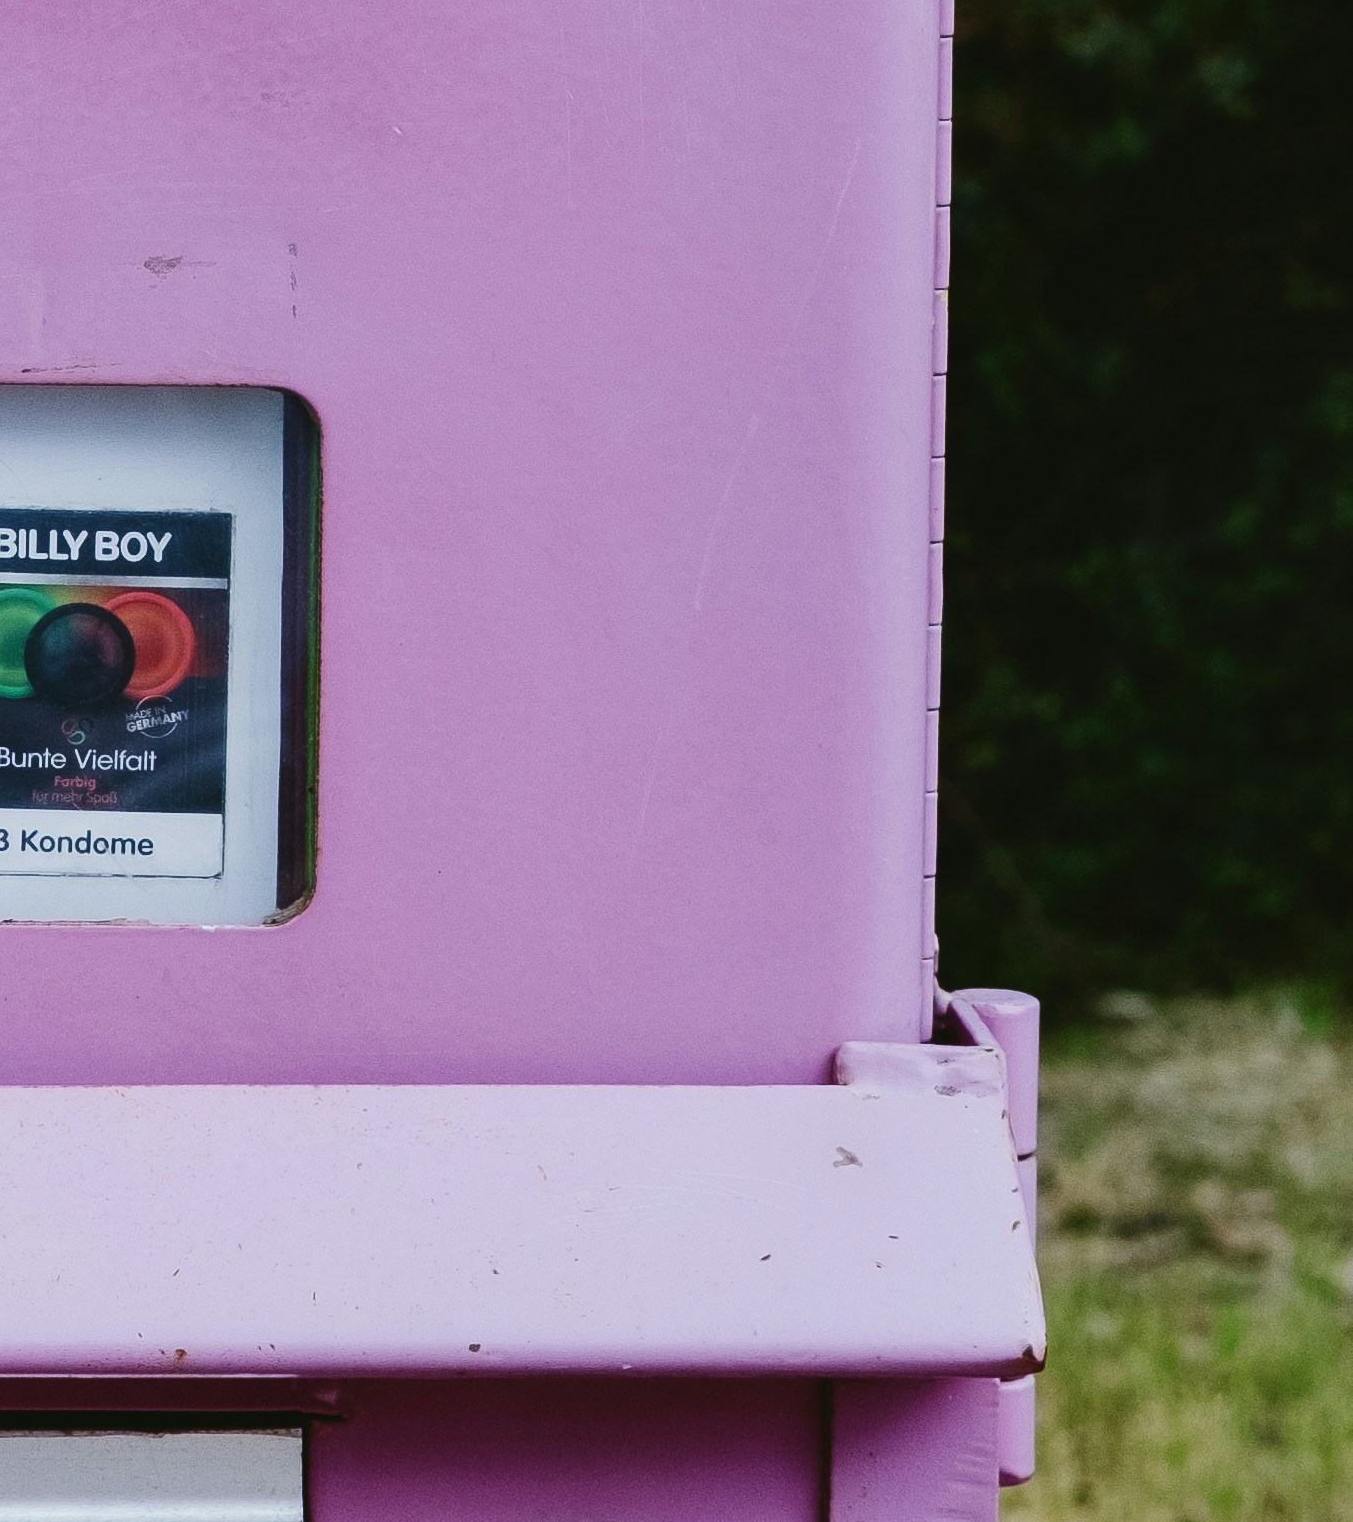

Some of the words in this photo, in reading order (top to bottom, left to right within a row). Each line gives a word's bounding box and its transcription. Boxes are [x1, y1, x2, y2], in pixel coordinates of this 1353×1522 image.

[94, 530, 173, 563] BOY
[126, 709, 190, 732] GERMANY
[75, 748, 157, 772] Vielfalt
[53, 775, 97, 791] Farbig
[51, 790, 83, 803] mehr
[20, 829, 155, 856] Kondome
